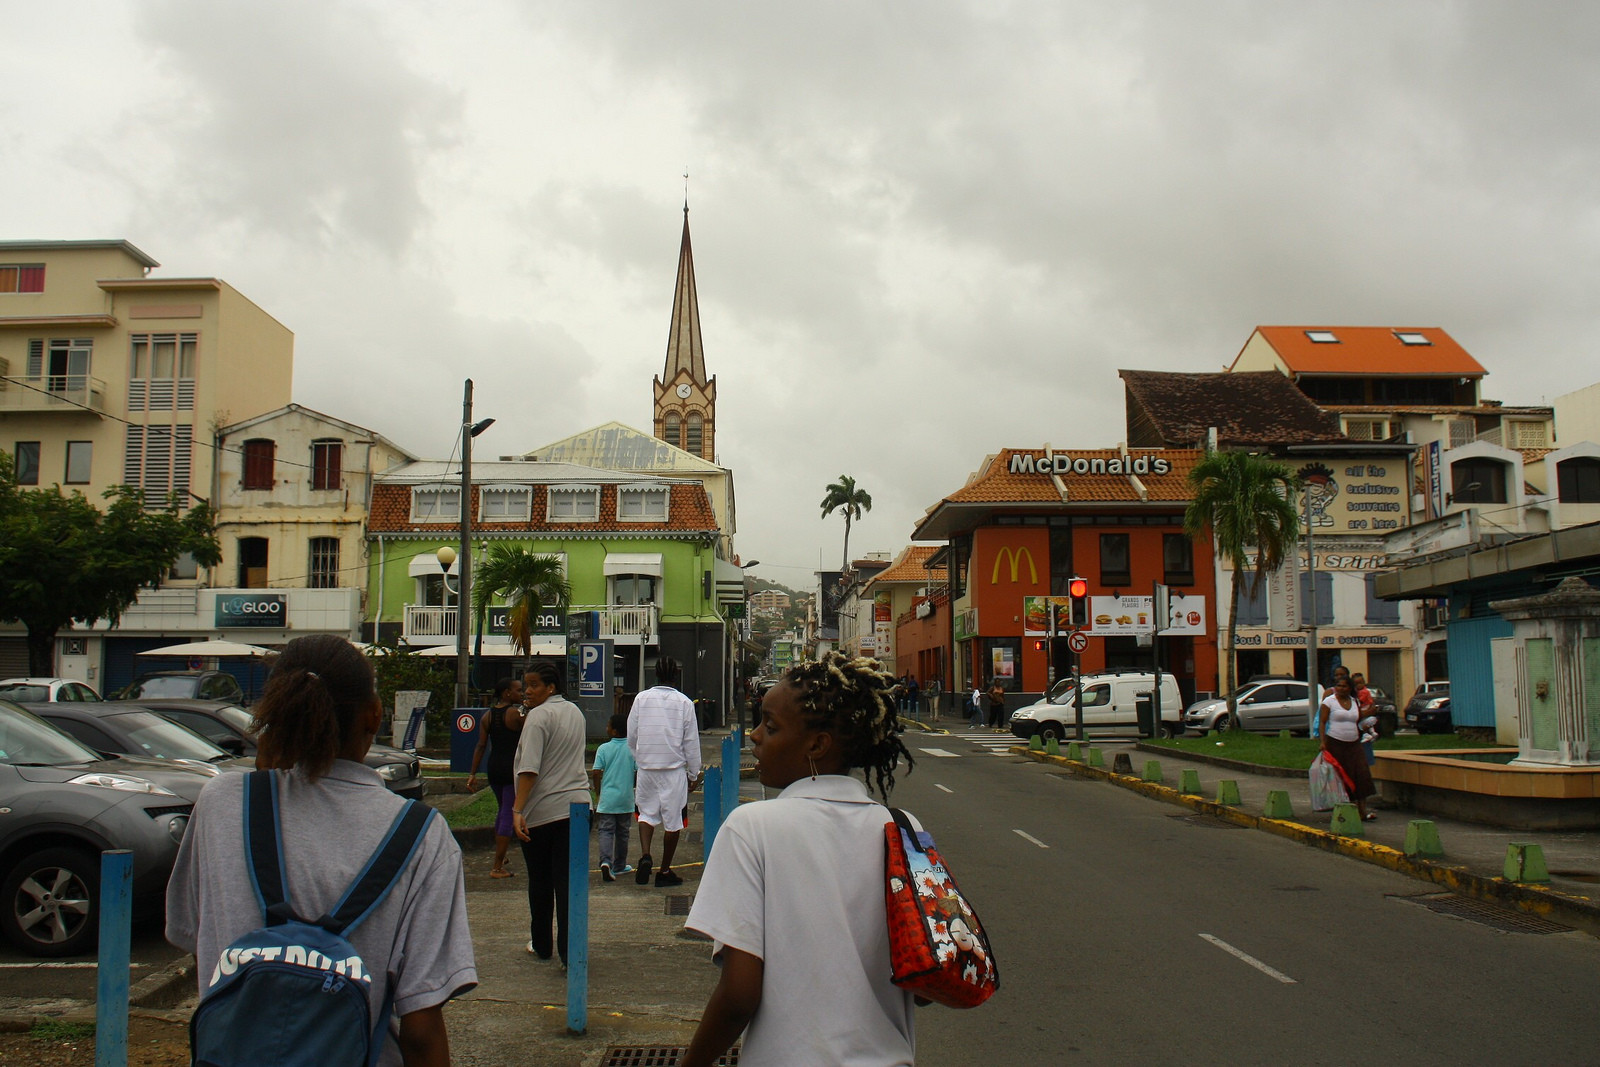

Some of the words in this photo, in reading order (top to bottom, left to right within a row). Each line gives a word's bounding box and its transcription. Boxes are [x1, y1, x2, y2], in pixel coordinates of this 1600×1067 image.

[1009, 454, 1170, 475] McDonald's
[1345, 465, 1364, 477] all
[1367, 464, 1386, 477] the
[1430, 453, 1440, 499] Budget
[1346, 483, 1399, 495] exclusive
[1347, 502, 1400, 512] souvenirs
[1348, 519, 1367, 529] are
[1372, 517, 1397, 529] here
[493, 614, 506, 627] LE
[1234, 633, 1261, 645] tout
[1338, 634, 1389, 645] souvenir
[582, 646, 598, 670] P
[209, 946, 283, 987] JUST
